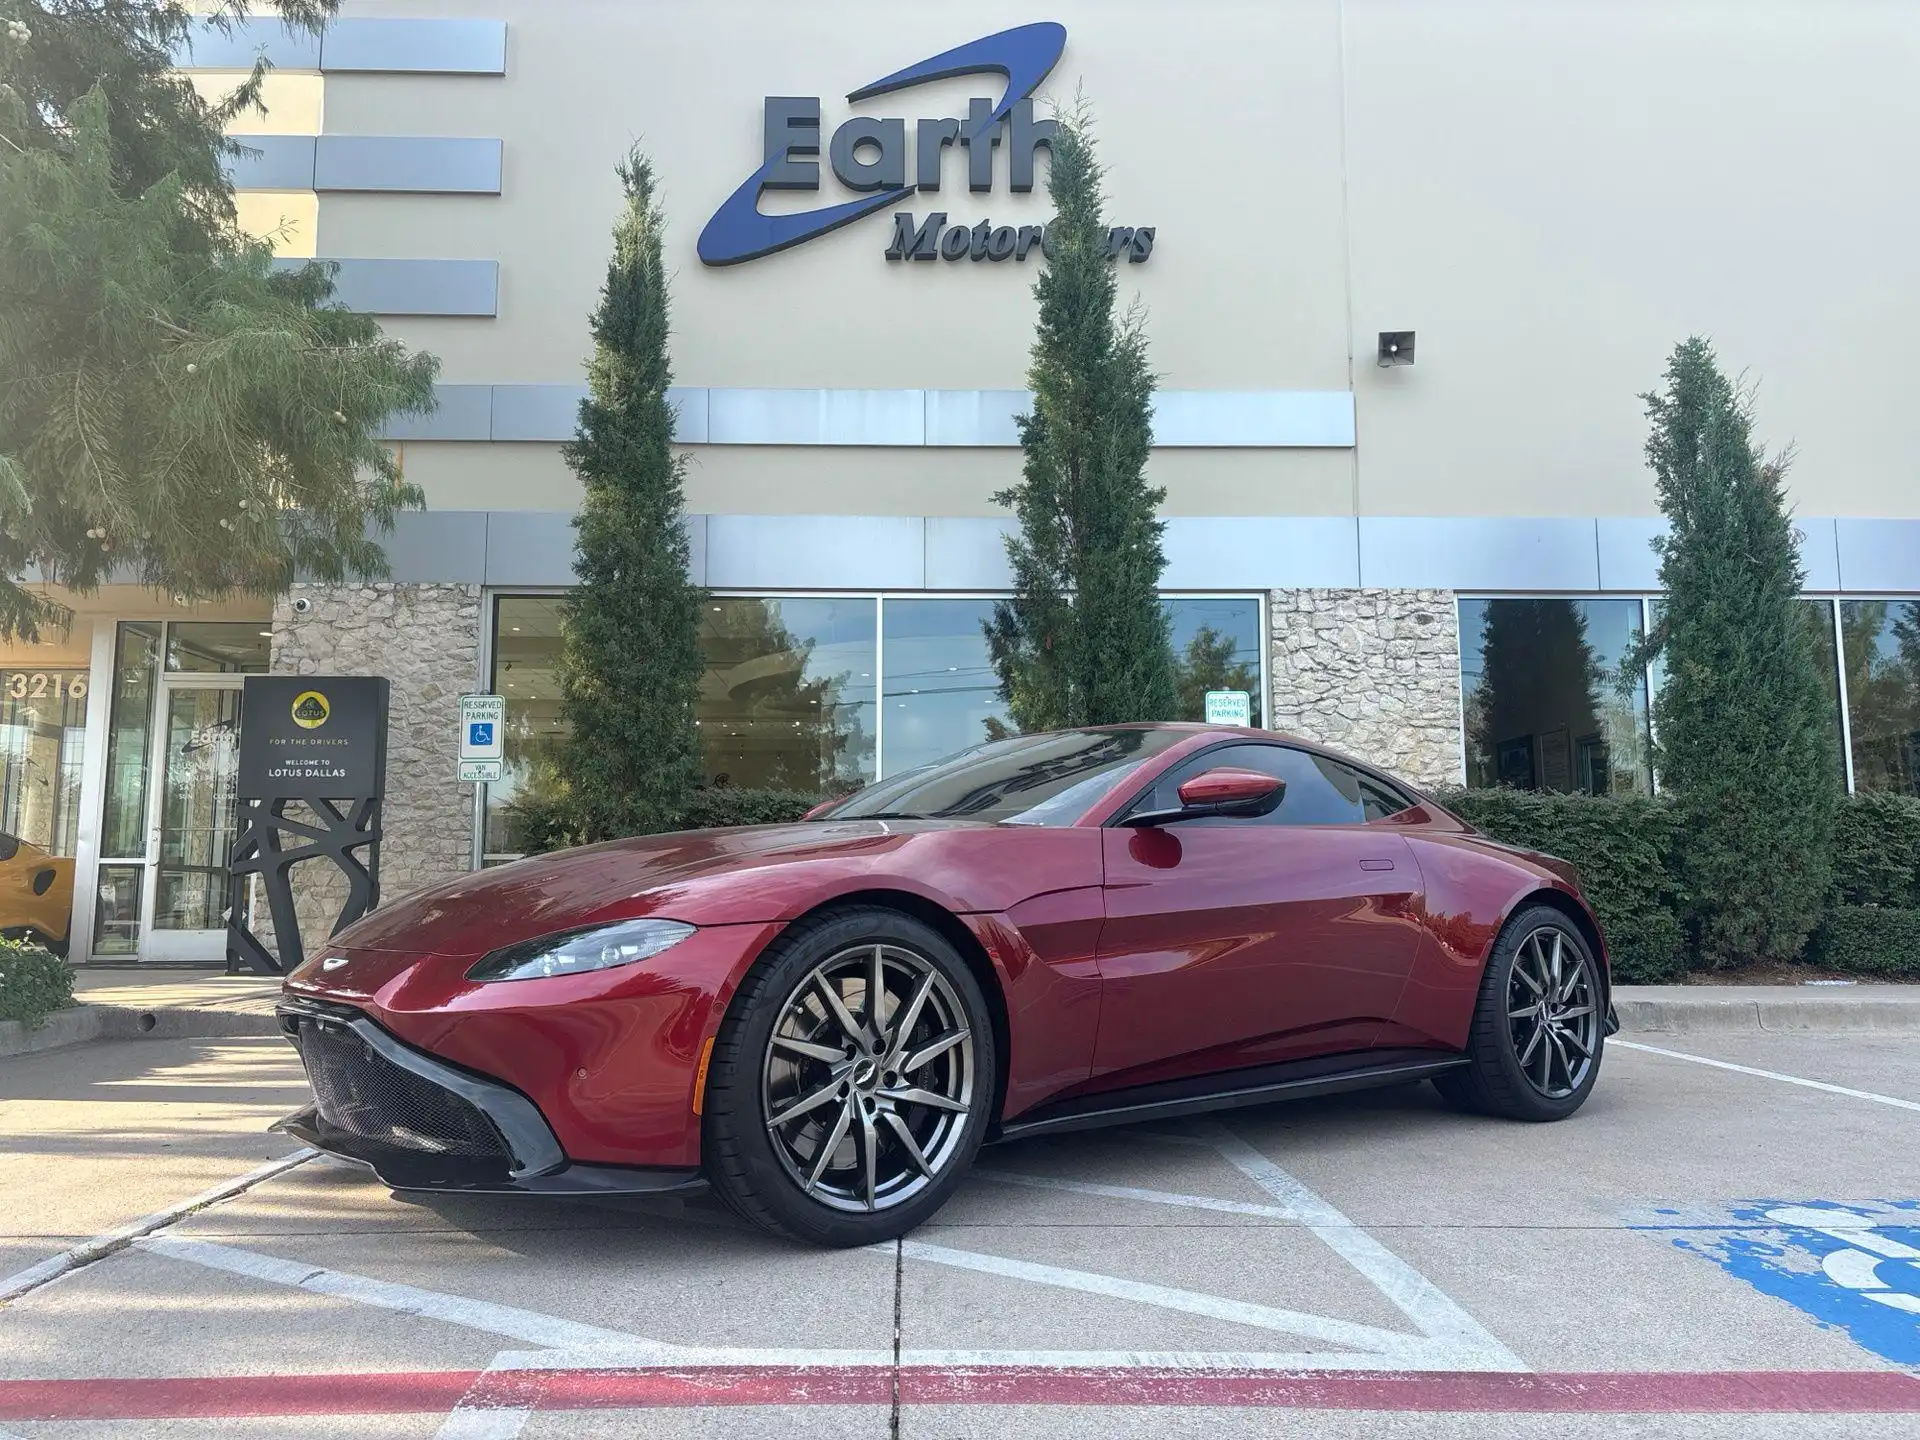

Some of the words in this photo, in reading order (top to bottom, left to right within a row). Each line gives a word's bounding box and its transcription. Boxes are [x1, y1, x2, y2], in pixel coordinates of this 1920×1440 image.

[764, 96, 1071, 193] Earth
[885, 212, 1156, 263] Motorrs
[10, 673, 88, 699] 3216
[464, 701, 502, 709] RESERVED
[1208, 699, 1246, 707] RESERVED
[296, 709, 325, 717] LOTUS
[466, 711, 499, 720] PARKING
[1211, 709, 1244, 717] PARKING
[268, 768, 302, 777] LOTUS
[305, 768, 346, 777] DALLAS
